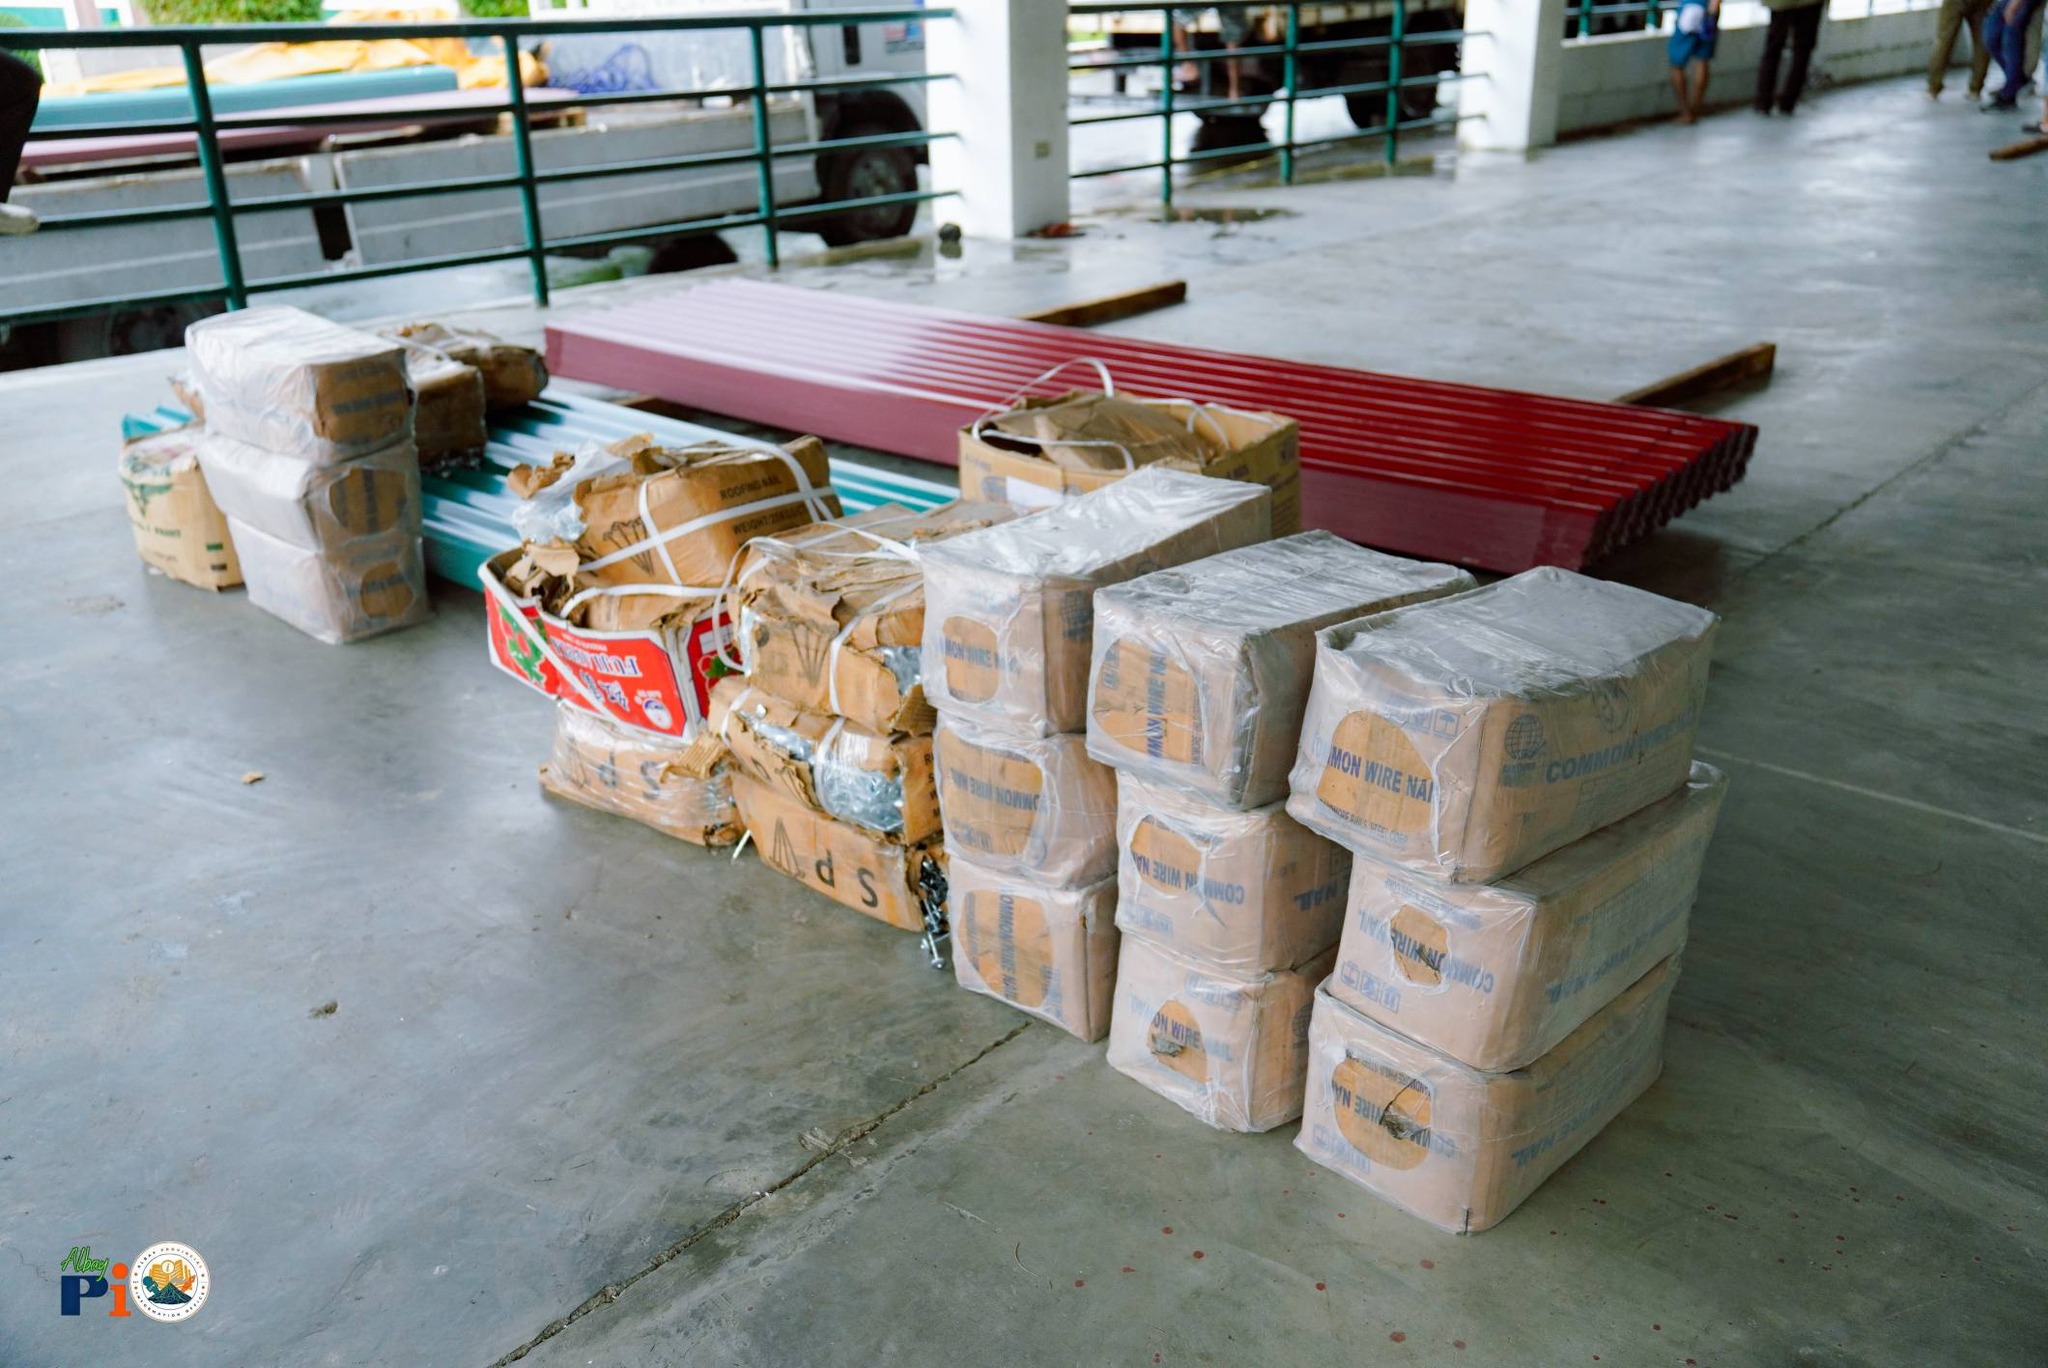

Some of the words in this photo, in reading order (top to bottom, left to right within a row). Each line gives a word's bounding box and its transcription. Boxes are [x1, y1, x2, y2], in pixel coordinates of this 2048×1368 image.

[1364, 759, 1403, 793] WIRE
[1153, 861, 1181, 888] WIRE
[1185, 873, 1246, 904] COMMN
[1171, 1018, 1201, 1048] WIRE
